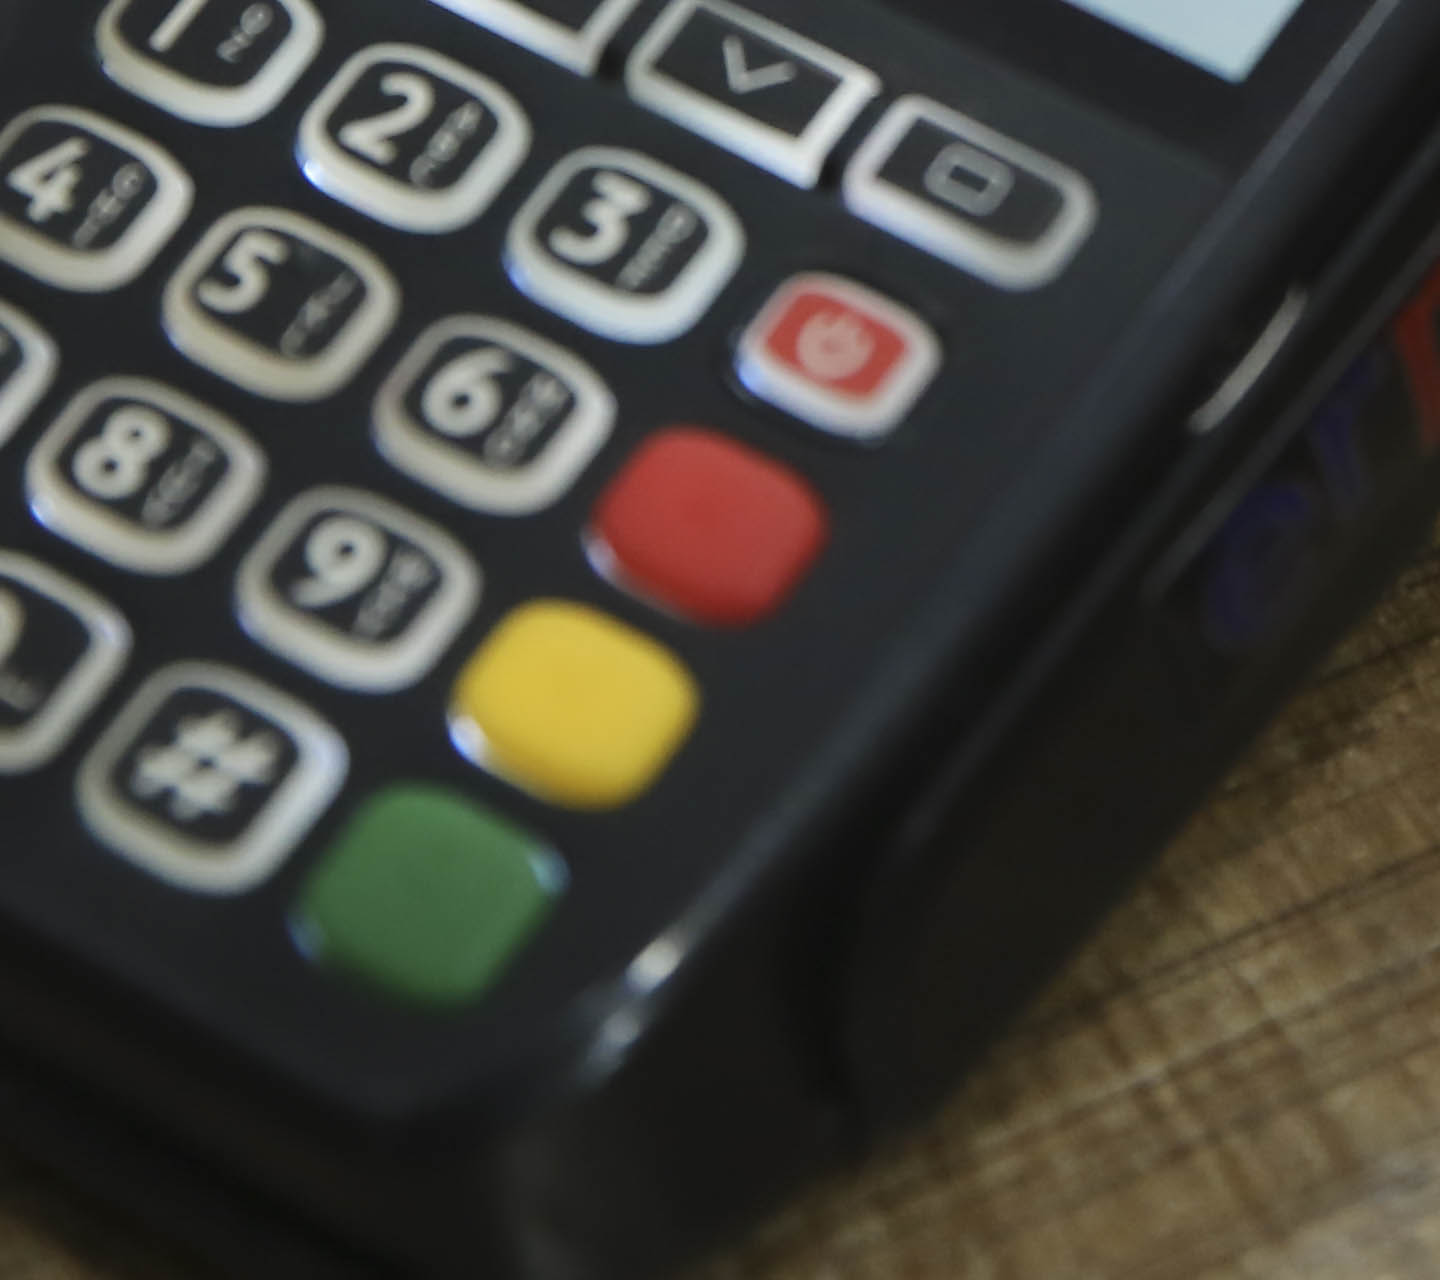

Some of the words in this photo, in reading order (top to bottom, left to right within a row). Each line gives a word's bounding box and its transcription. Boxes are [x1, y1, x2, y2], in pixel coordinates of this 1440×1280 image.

[339, 71, 436, 165] 2
[6, 135, 92, 224] 4
[548, 170, 653, 266] 3
[198, 231, 291, 314] 5
[421, 346, 516, 439] 6
[71, 404, 173, 500] 8
[288, 516, 389, 610] 9
